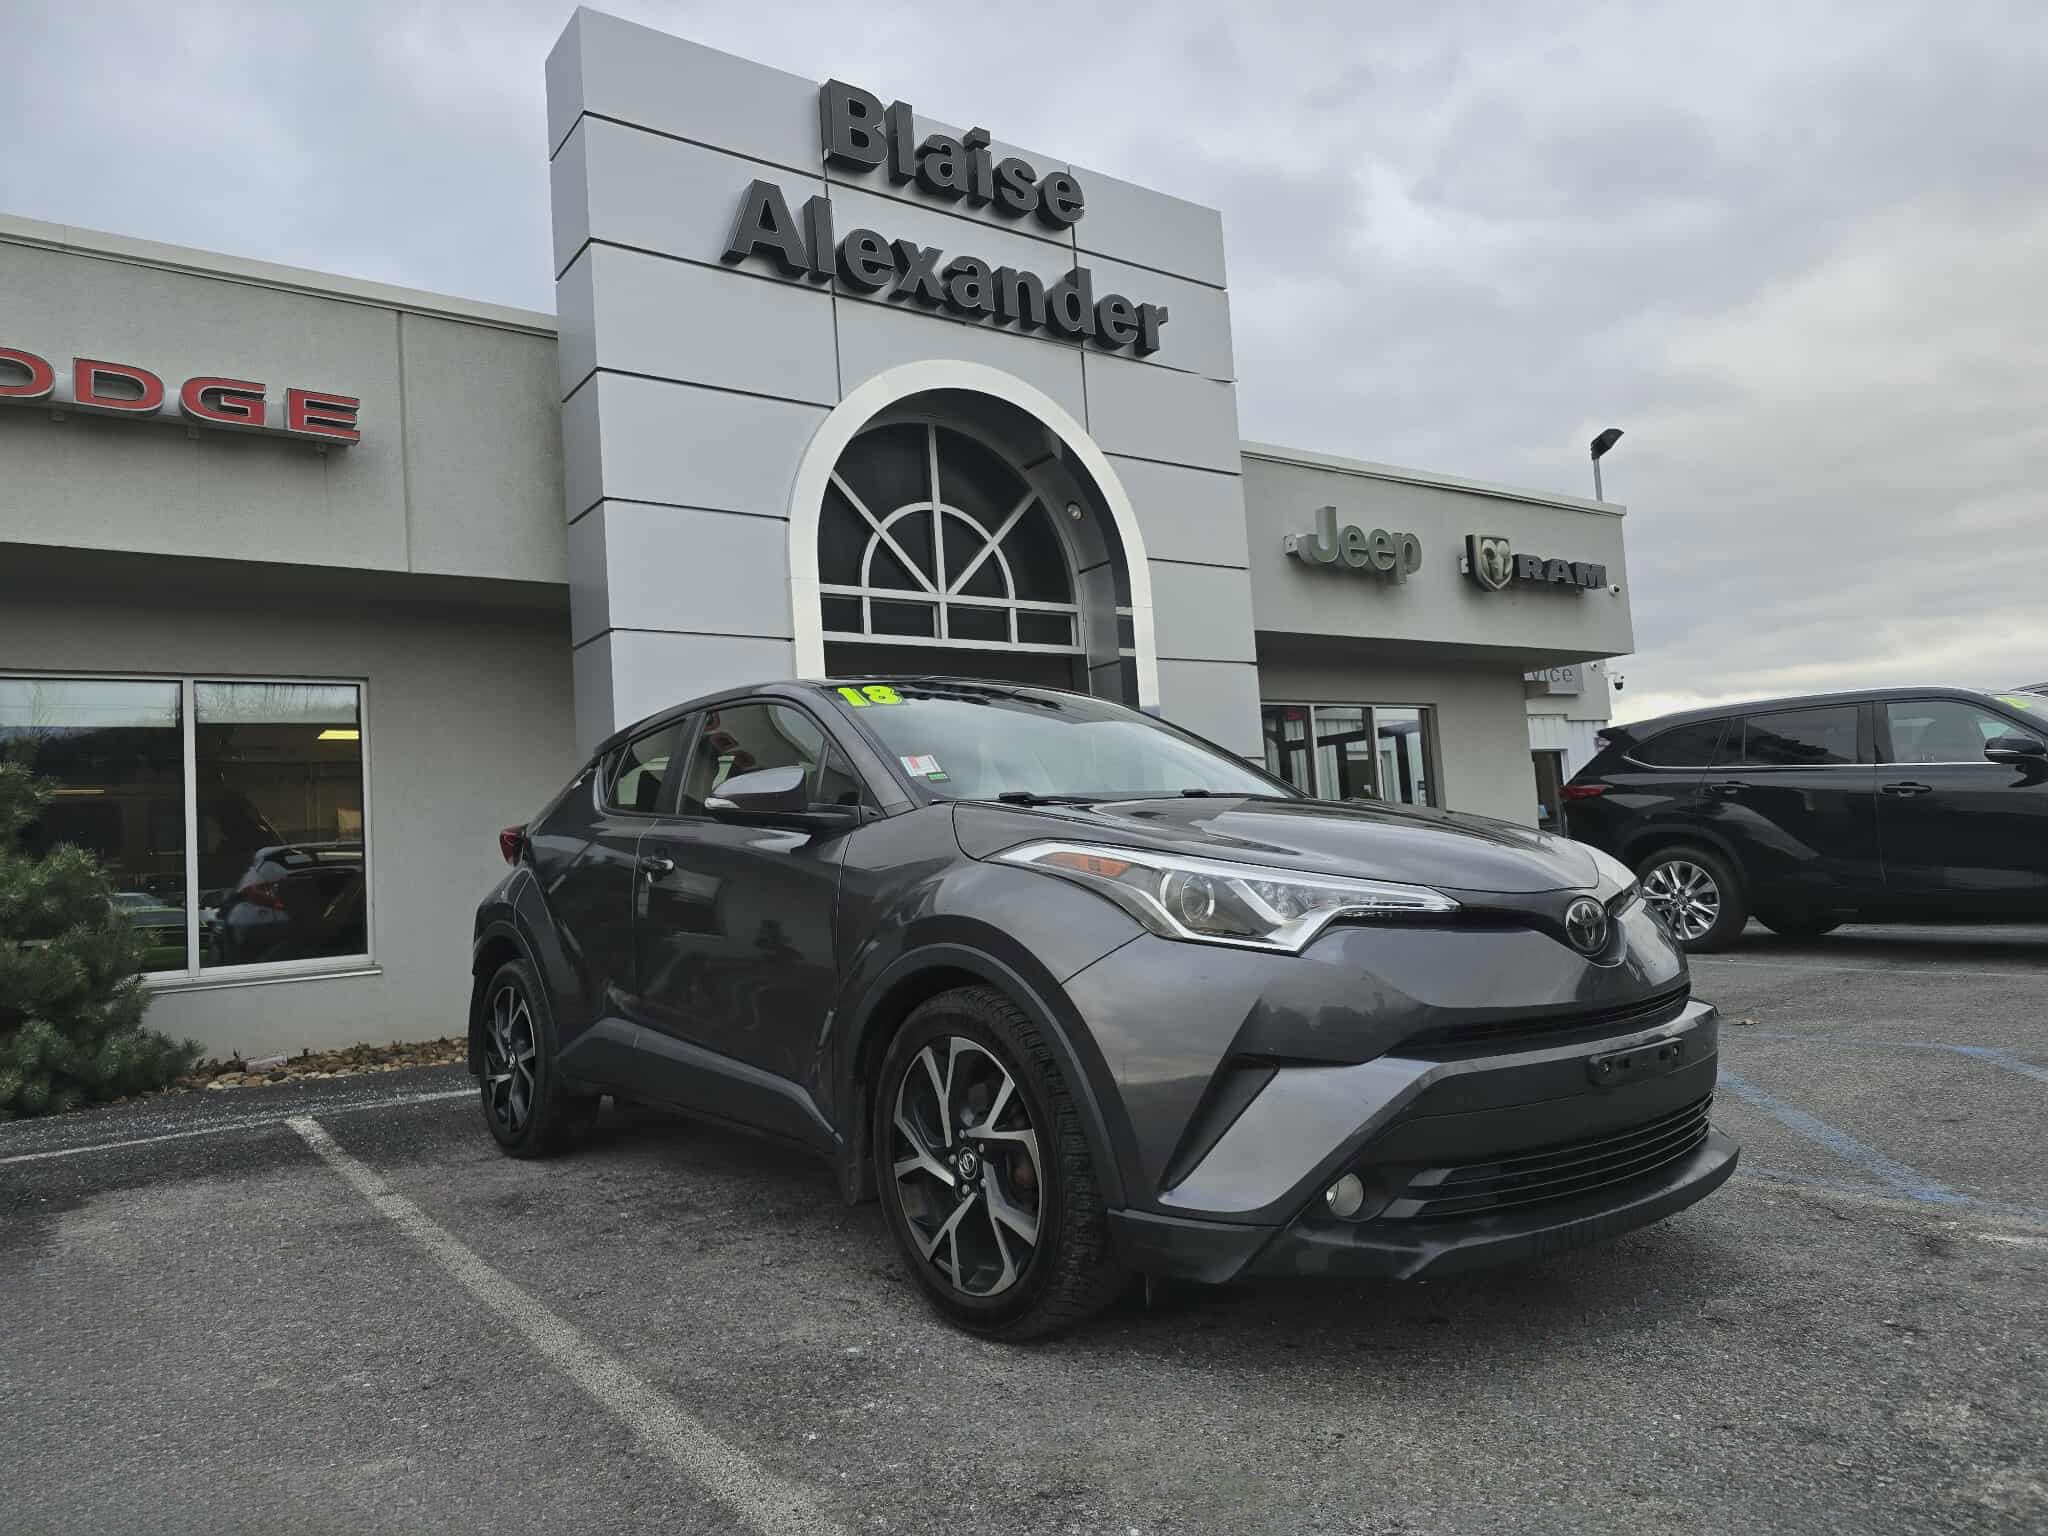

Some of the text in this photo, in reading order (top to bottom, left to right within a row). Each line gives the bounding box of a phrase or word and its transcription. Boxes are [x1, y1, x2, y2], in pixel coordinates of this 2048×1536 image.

[820, 79, 1084, 228] Blaise
[720, 179, 1168, 357] Alexander
[1300, 506, 1422, 584] Jeep
[1513, 553, 1607, 590] RAM
[838, 686, 902, 706] 18
